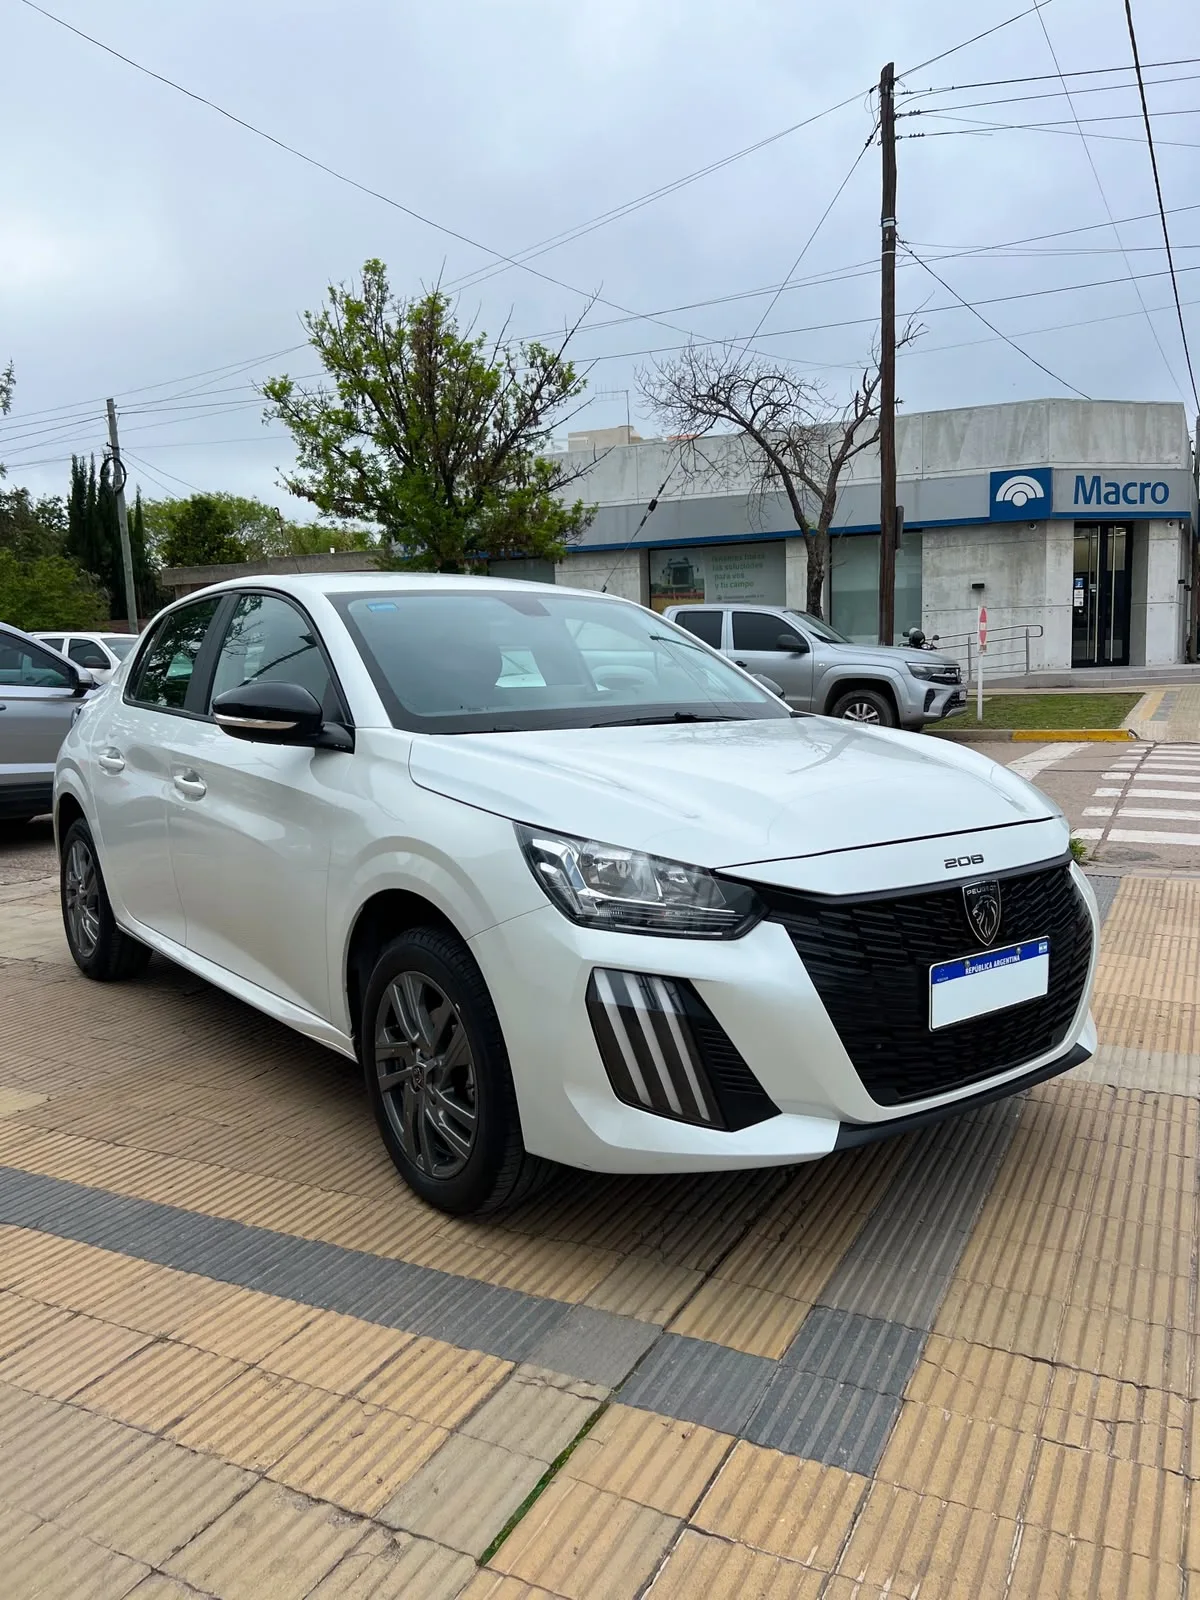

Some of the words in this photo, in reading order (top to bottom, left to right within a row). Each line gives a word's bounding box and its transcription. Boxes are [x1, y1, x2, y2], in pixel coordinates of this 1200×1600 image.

[1073, 475, 1170, 505] Macro
[714, 573, 731, 582] para
[732, 572, 745, 580] vos
[729, 580, 754, 589] campo
[943, 854, 984, 869] 208
[965, 963, 993, 975] REPÚBLICA
[993, 954, 1021, 968] ARGENTINA
